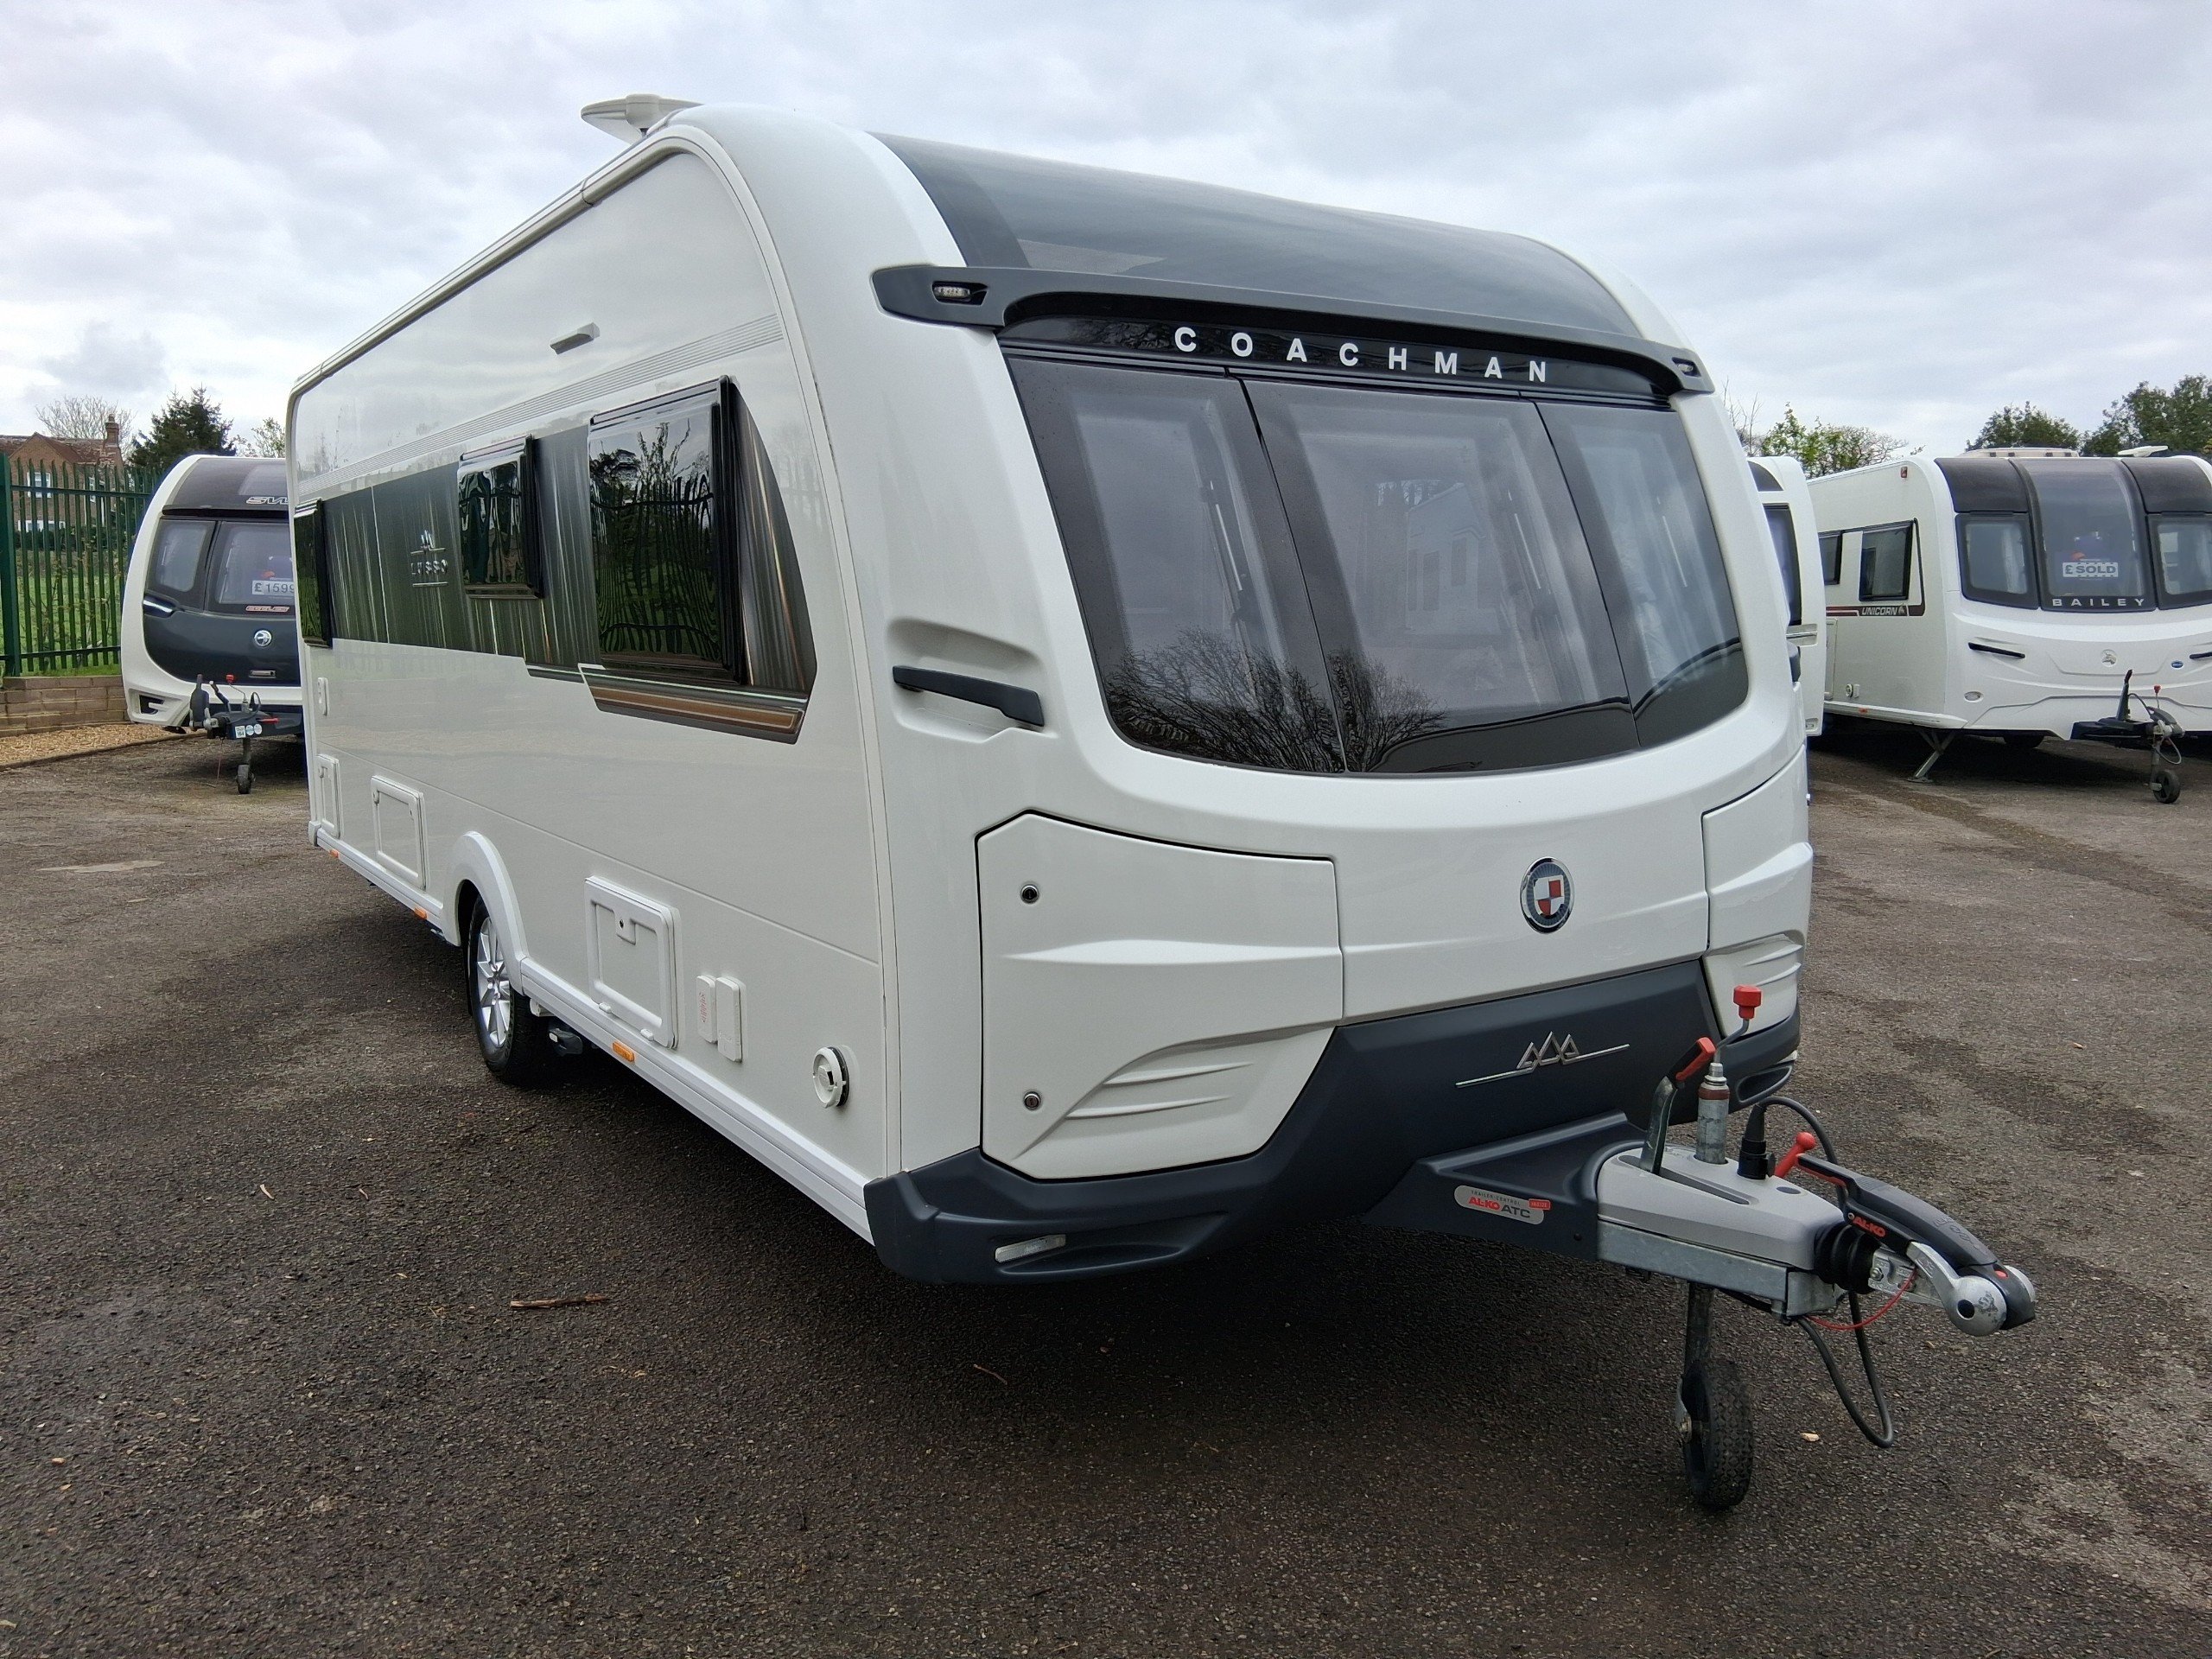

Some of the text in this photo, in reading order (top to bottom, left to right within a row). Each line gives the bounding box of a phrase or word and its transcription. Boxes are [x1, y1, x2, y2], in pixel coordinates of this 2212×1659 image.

[1174, 327, 1546, 383] COACHMAN
[2052, 598, 2145, 607] BAILEY
[1861, 607, 1897, 616] UNICORN
[1501, 1204, 1530, 1218] ATC
[1853, 1216, 1886, 1237] AL-KO
